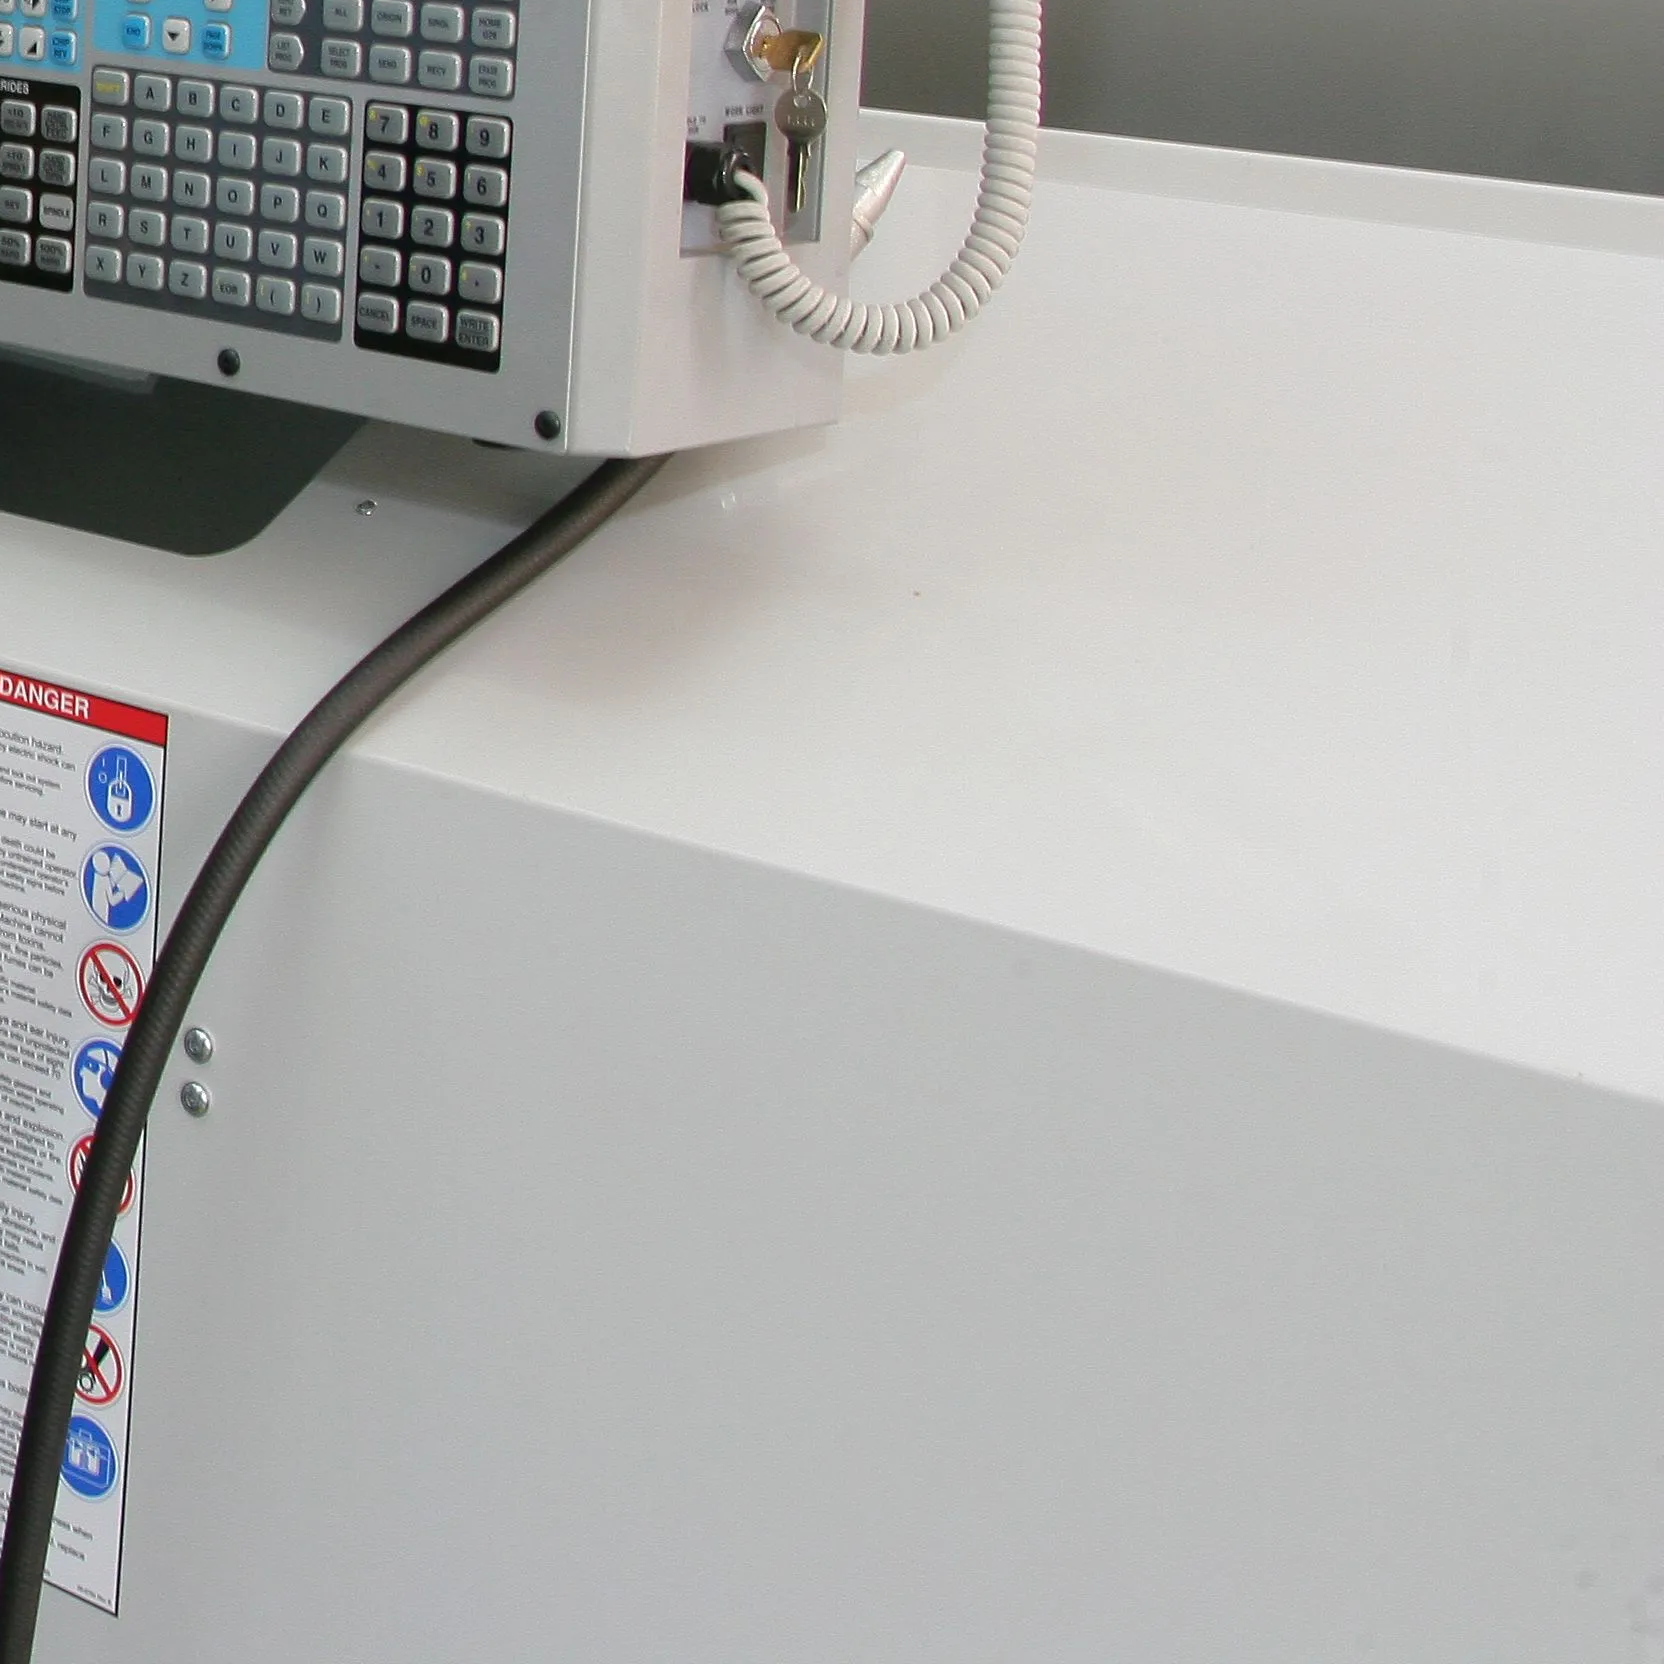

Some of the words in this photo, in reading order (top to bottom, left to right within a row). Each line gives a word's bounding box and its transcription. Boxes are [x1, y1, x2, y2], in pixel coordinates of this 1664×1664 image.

[146, 88, 154, 100] A
[189, 93, 197, 105] B
[231, 99, 240, 112] C
[276, 105, 285, 117] D
[322, 109, 331, 122] E
[379, 116, 390, 132] 7
[103, 126, 110, 136] F
[429, 124, 439, 141] 8
[479, 129, 490, 146] 9
[144, 132, 153, 144] G
[187, 138, 195, 150] H
[233, 145, 236, 157] I
[276, 151, 283, 163] J
[319, 157, 329, 170] K
[101, 170, 108, 182] L
[377, 165, 386, 180] 4
[141, 176, 152, 188] M
[426, 172, 436, 188] 5
[477, 178, 487, 195] 6
[184, 183, 194, 196] N
[228, 190, 238, 203] O
[273, 196, 282, 209] P
[317, 204, 328, 218] Q
[99, 214, 107, 225] R
[376, 212, 383, 227] 1
[140, 222, 148, 234] S
[184, 228, 191, 241] T
[424, 220, 434, 236] 2
[226, 235, 235, 249] U
[475, 227, 484, 244] 3
[271, 243, 280, 255] V
[314, 250, 327, 264] W
[96, 258, 104, 270] X
[138, 265, 146, 278] Y
[421, 266, 431, 283] 0
[181, 274, 189, 286] Z
